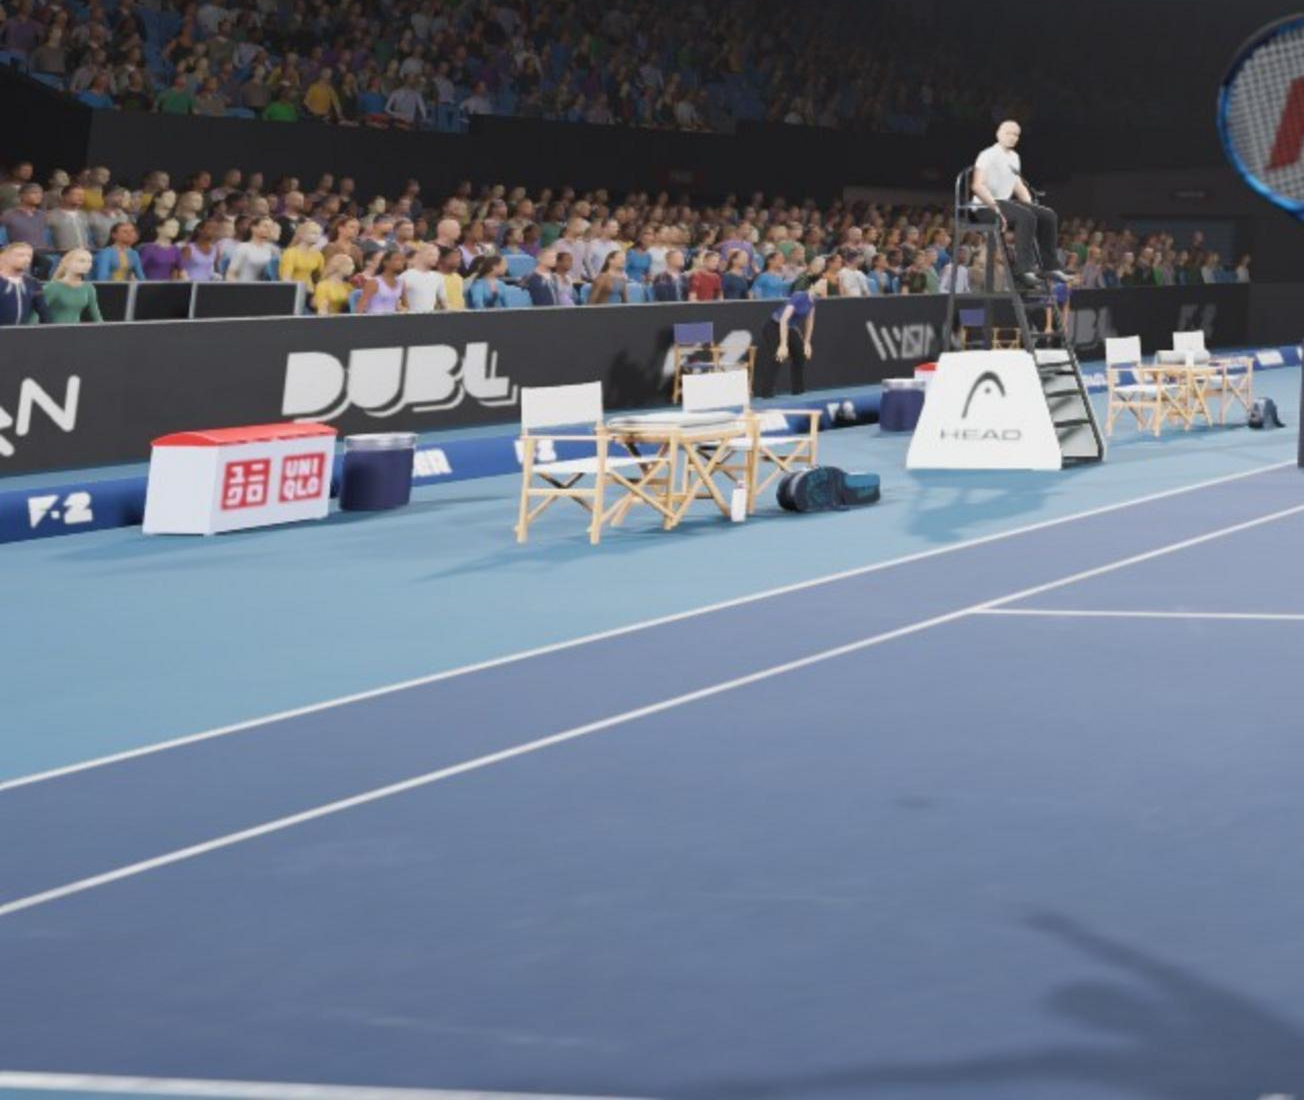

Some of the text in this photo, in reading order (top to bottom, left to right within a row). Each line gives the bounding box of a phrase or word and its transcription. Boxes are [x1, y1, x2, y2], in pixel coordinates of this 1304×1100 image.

[282, 342, 516, 421] DUBL
[940, 428, 1022, 440] HEAD
[285, 457, 320, 477] UNI
[283, 476, 320, 500] QLO
